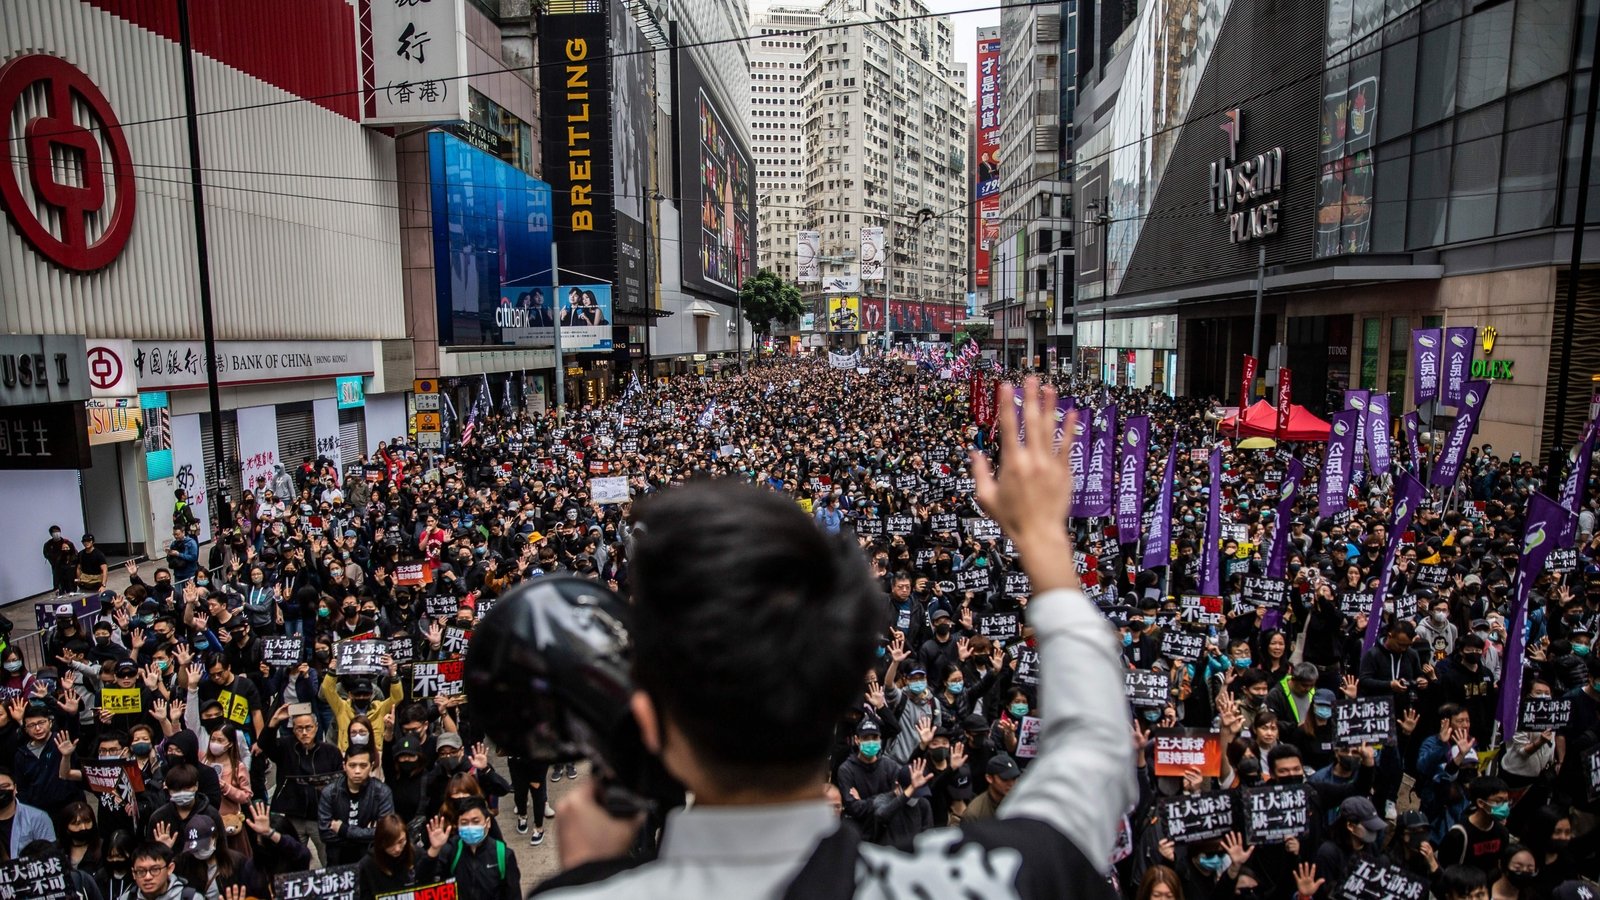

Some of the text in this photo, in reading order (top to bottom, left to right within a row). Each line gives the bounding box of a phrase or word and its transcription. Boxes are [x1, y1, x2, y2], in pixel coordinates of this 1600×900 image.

[386, 79, 447, 104] (香港)
[982, 57, 995, 130] 才是真貨
[566, 37, 593, 232] BREITLING
[1210, 147, 1283, 222] Hysan
[1230, 200, 1279, 244] PLACE
[496, 302, 530, 328] citibank
[1328, 346, 1348, 356] TUDOR
[233, 354, 262, 370] BANK
[265, 354, 278, 368] OF
[281, 353, 313, 368] CHINA
[1472, 359, 1514, 379] OLEX
[888, 516, 913, 525] 五大訴求
[931, 514, 957, 522] 五大訴求
[887, 524, 912, 532] 缺一不可
[931, 521, 958, 529] 缺一不可
[956, 570, 988, 580] 五大訴求
[1420, 566, 1448, 576] 五大訴求
[957, 579, 990, 589] 缺一不可
[1006, 576, 1030, 584] 五大訴
[1245, 576, 1284, 590] 五大訴求
[1416, 573, 1446, 583] 缺一不可
[1244, 586, 1283, 600] 缺一不可
[1343, 594, 1374, 602] 五大訴求
[426, 597, 457, 606] 五大訴求
[1341, 602, 1372, 612] 缺一不可
[426, 605, 458, 614] 缺一不可
[981, 616, 1016, 626] 五大訴求
[981, 625, 1016, 635] 缺一不可
[265, 639, 301, 649] 五大訴求
[1164, 632, 1202, 647] 五大訴求
[264, 650, 300, 660] 缺一不可
[343, 643, 386, 655] 五大訴求
[1162, 643, 1200, 657] 缺一不可
[1020, 651, 1040, 662] 五大
[414, 662, 438, 675] 我們
[1018, 664, 1040, 674] 缺一
[1126, 674, 1168, 687] 五大訴求
[1126, 686, 1168, 698] 缺一不可
[1337, 701, 1389, 720] 五大訴求
[1525, 700, 1571, 712] 五大訴求
[1523, 711, 1570, 724] 缺一不可
[1336, 718, 1390, 734] 缺一不可
[1157, 737, 1204, 750] 五大訴求
[1167, 794, 1232, 819] 五大訴求
[1250, 790, 1306, 812] 五大訴求
[1168, 811, 1233, 836] 缺一不可
[1252, 808, 1307, 830] 缺一不可
[284, 870, 356, 900] 五大訴求
[1354, 859, 1422, 900] 五大訴求
